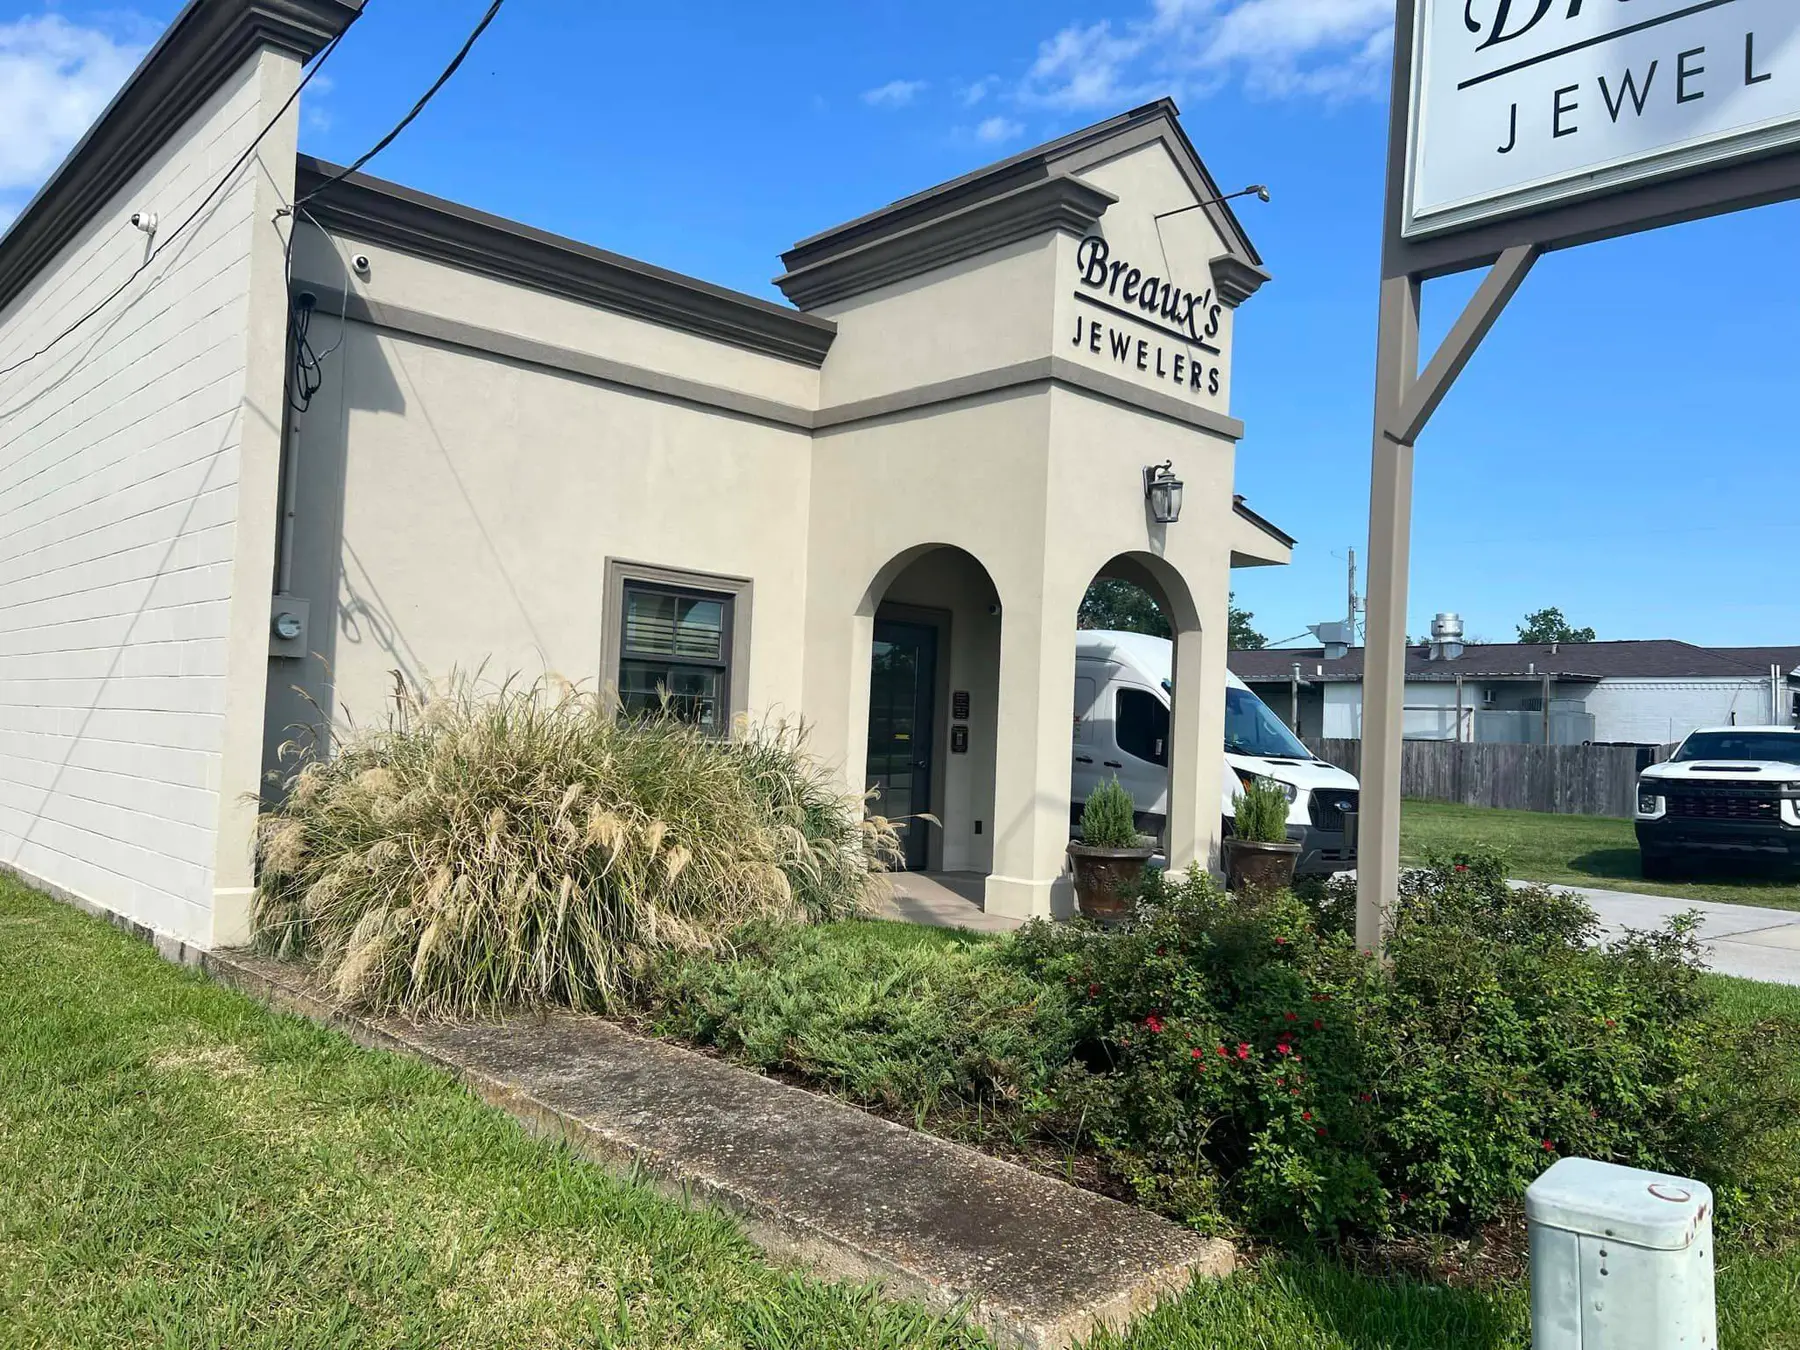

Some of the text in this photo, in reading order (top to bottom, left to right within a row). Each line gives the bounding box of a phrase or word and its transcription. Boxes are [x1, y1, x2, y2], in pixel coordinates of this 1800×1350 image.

[1497, 32, 1772, 154] JEWEL
[1077, 235, 1222, 341] Breaux's
[1072, 315, 1220, 395] JEWELERS
